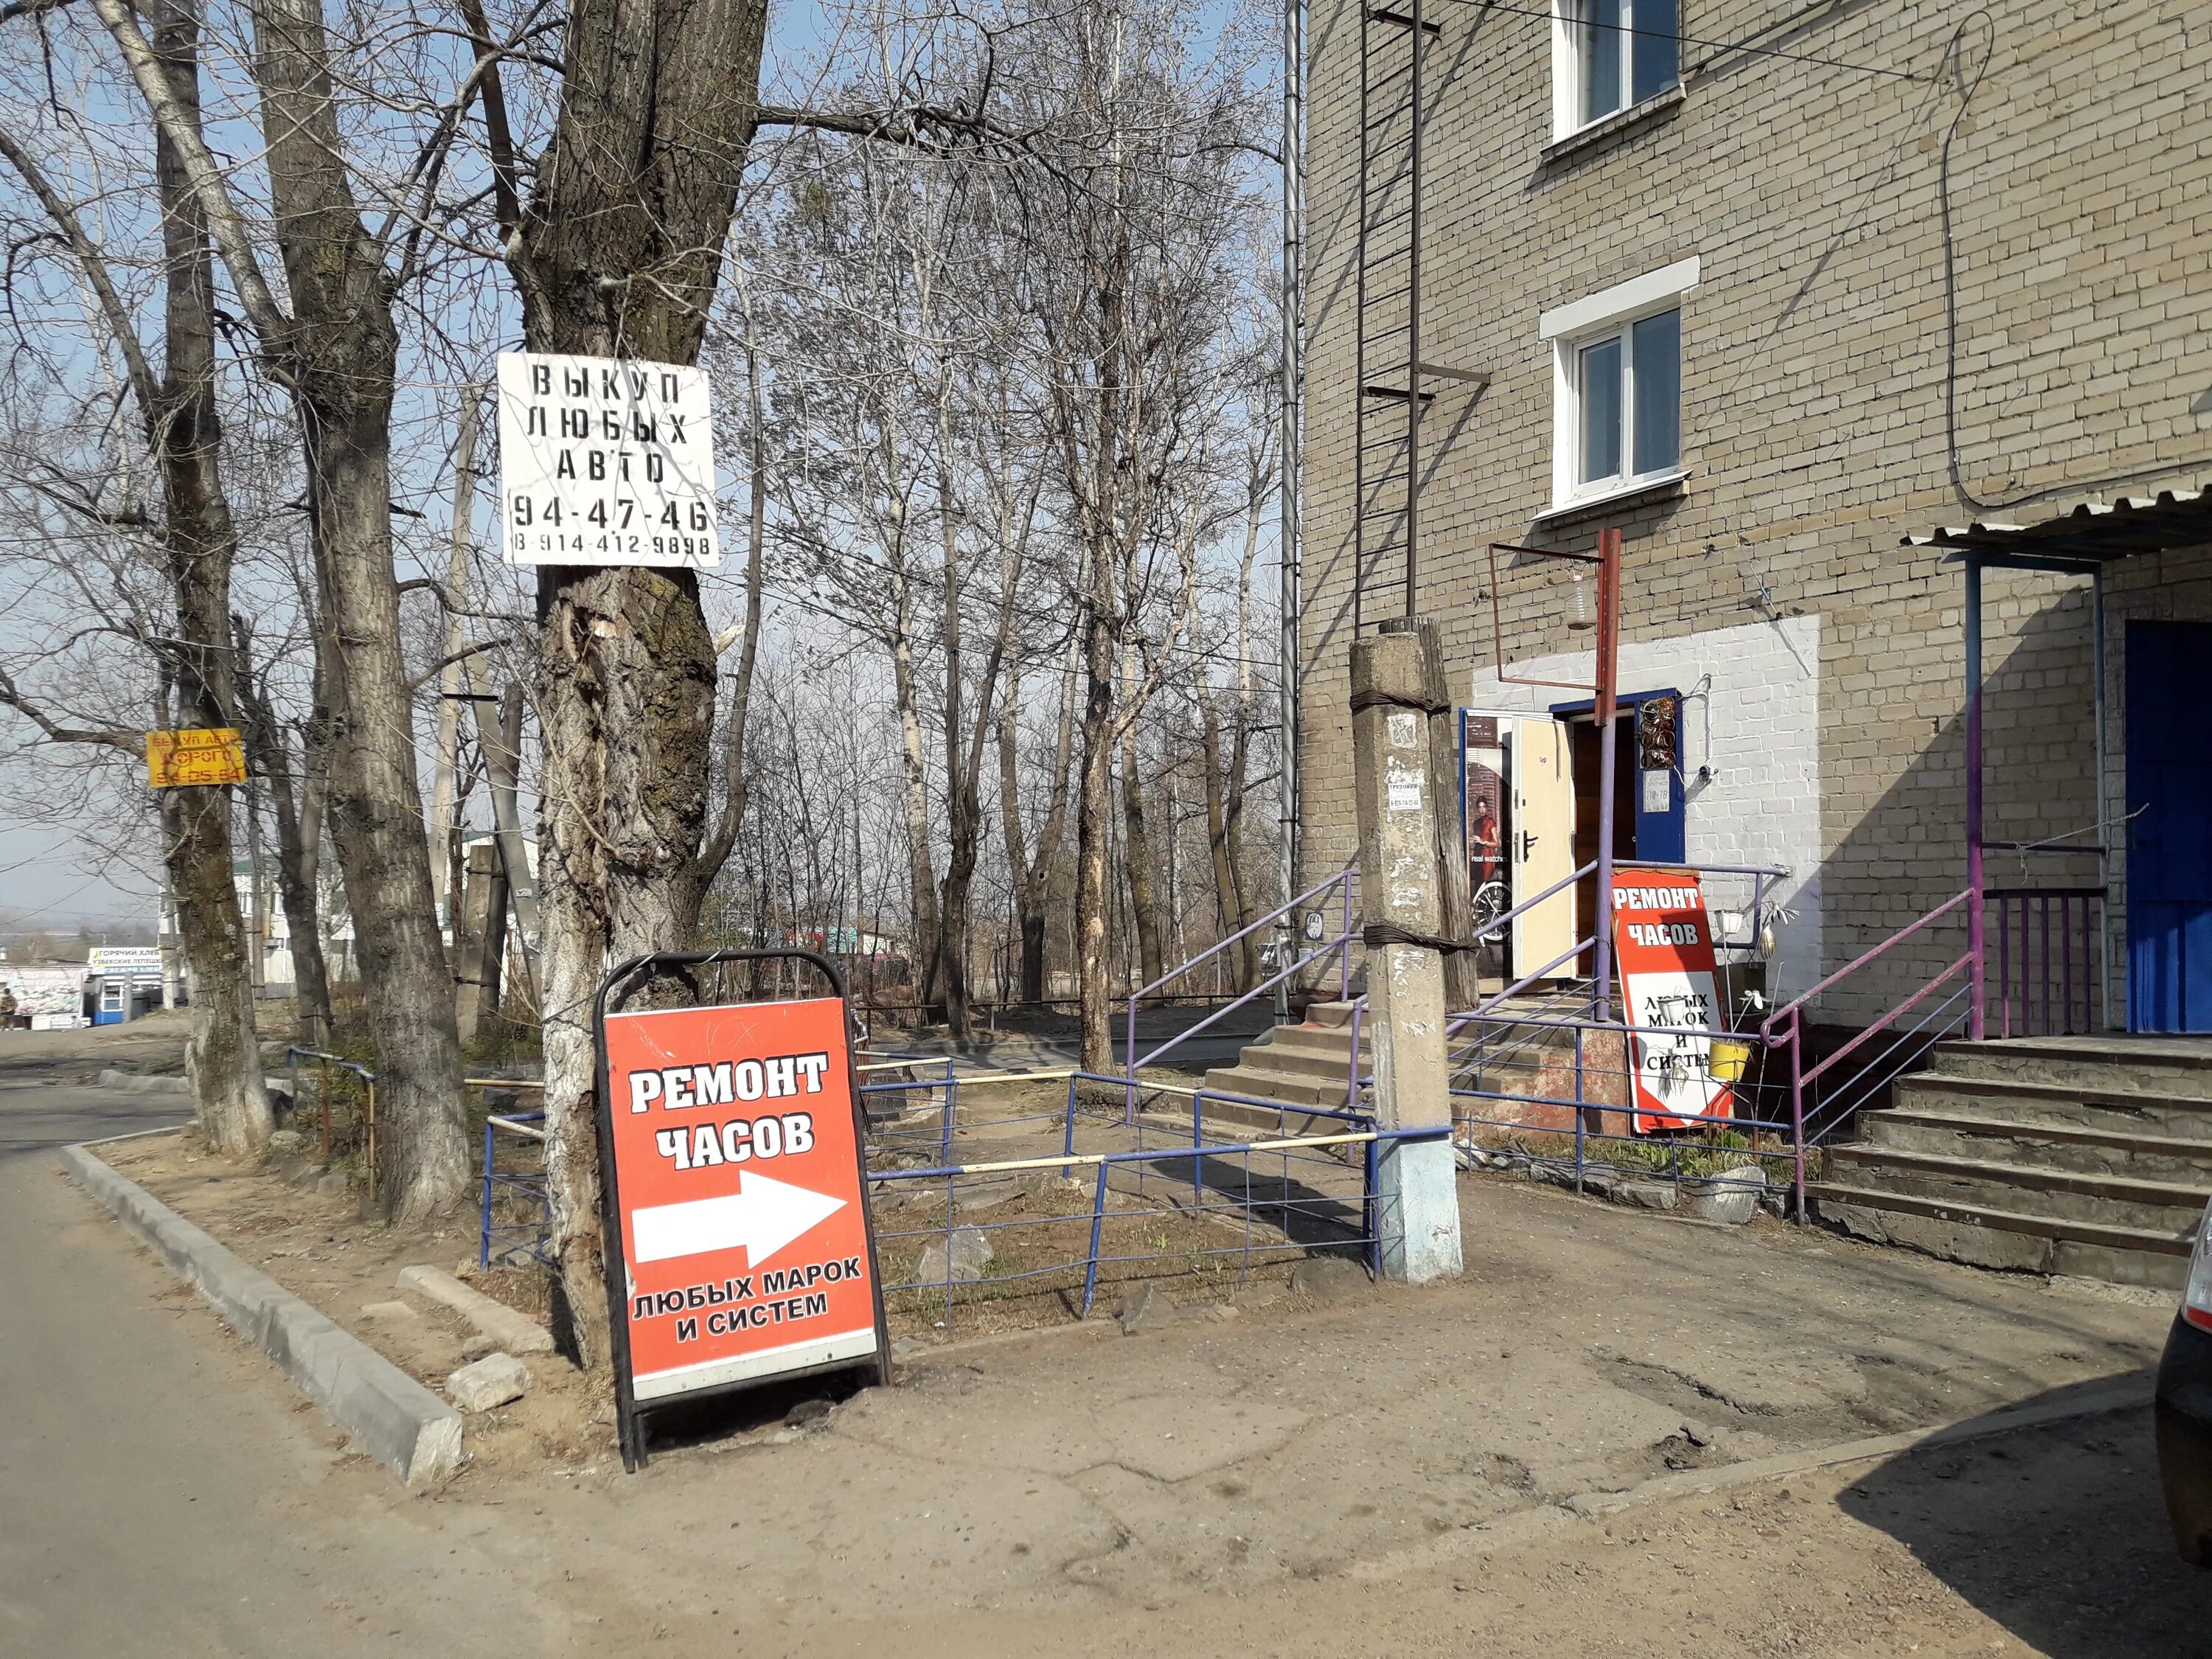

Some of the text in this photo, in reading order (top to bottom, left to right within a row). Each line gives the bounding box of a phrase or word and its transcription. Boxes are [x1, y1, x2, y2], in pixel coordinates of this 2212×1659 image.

[532, 364, 678, 403] ВЫКУП
[527, 406, 687, 444] ЛЮБЫХ
[557, 448, 664, 483] АВТО
[515, 495, 708, 532] 94-47-46
[1612, 887, 1699, 910] РЕМОНТ
[1627, 922, 1699, 947] ЧАСОВ
[1645, 994, 1709, 1010] ЛЫХ
[1647, 1012, 1710, 1027] МОК
[1674, 1034, 1688, 1048] И
[629, 1051, 829, 1114] РЕМОНТ
[655, 1112, 815, 1171] ЧАСОВ
[633, 1256, 862, 1320] ЛЮБЫХ МАРОК
[675, 1292, 828, 1343] И СИСТЕМ
